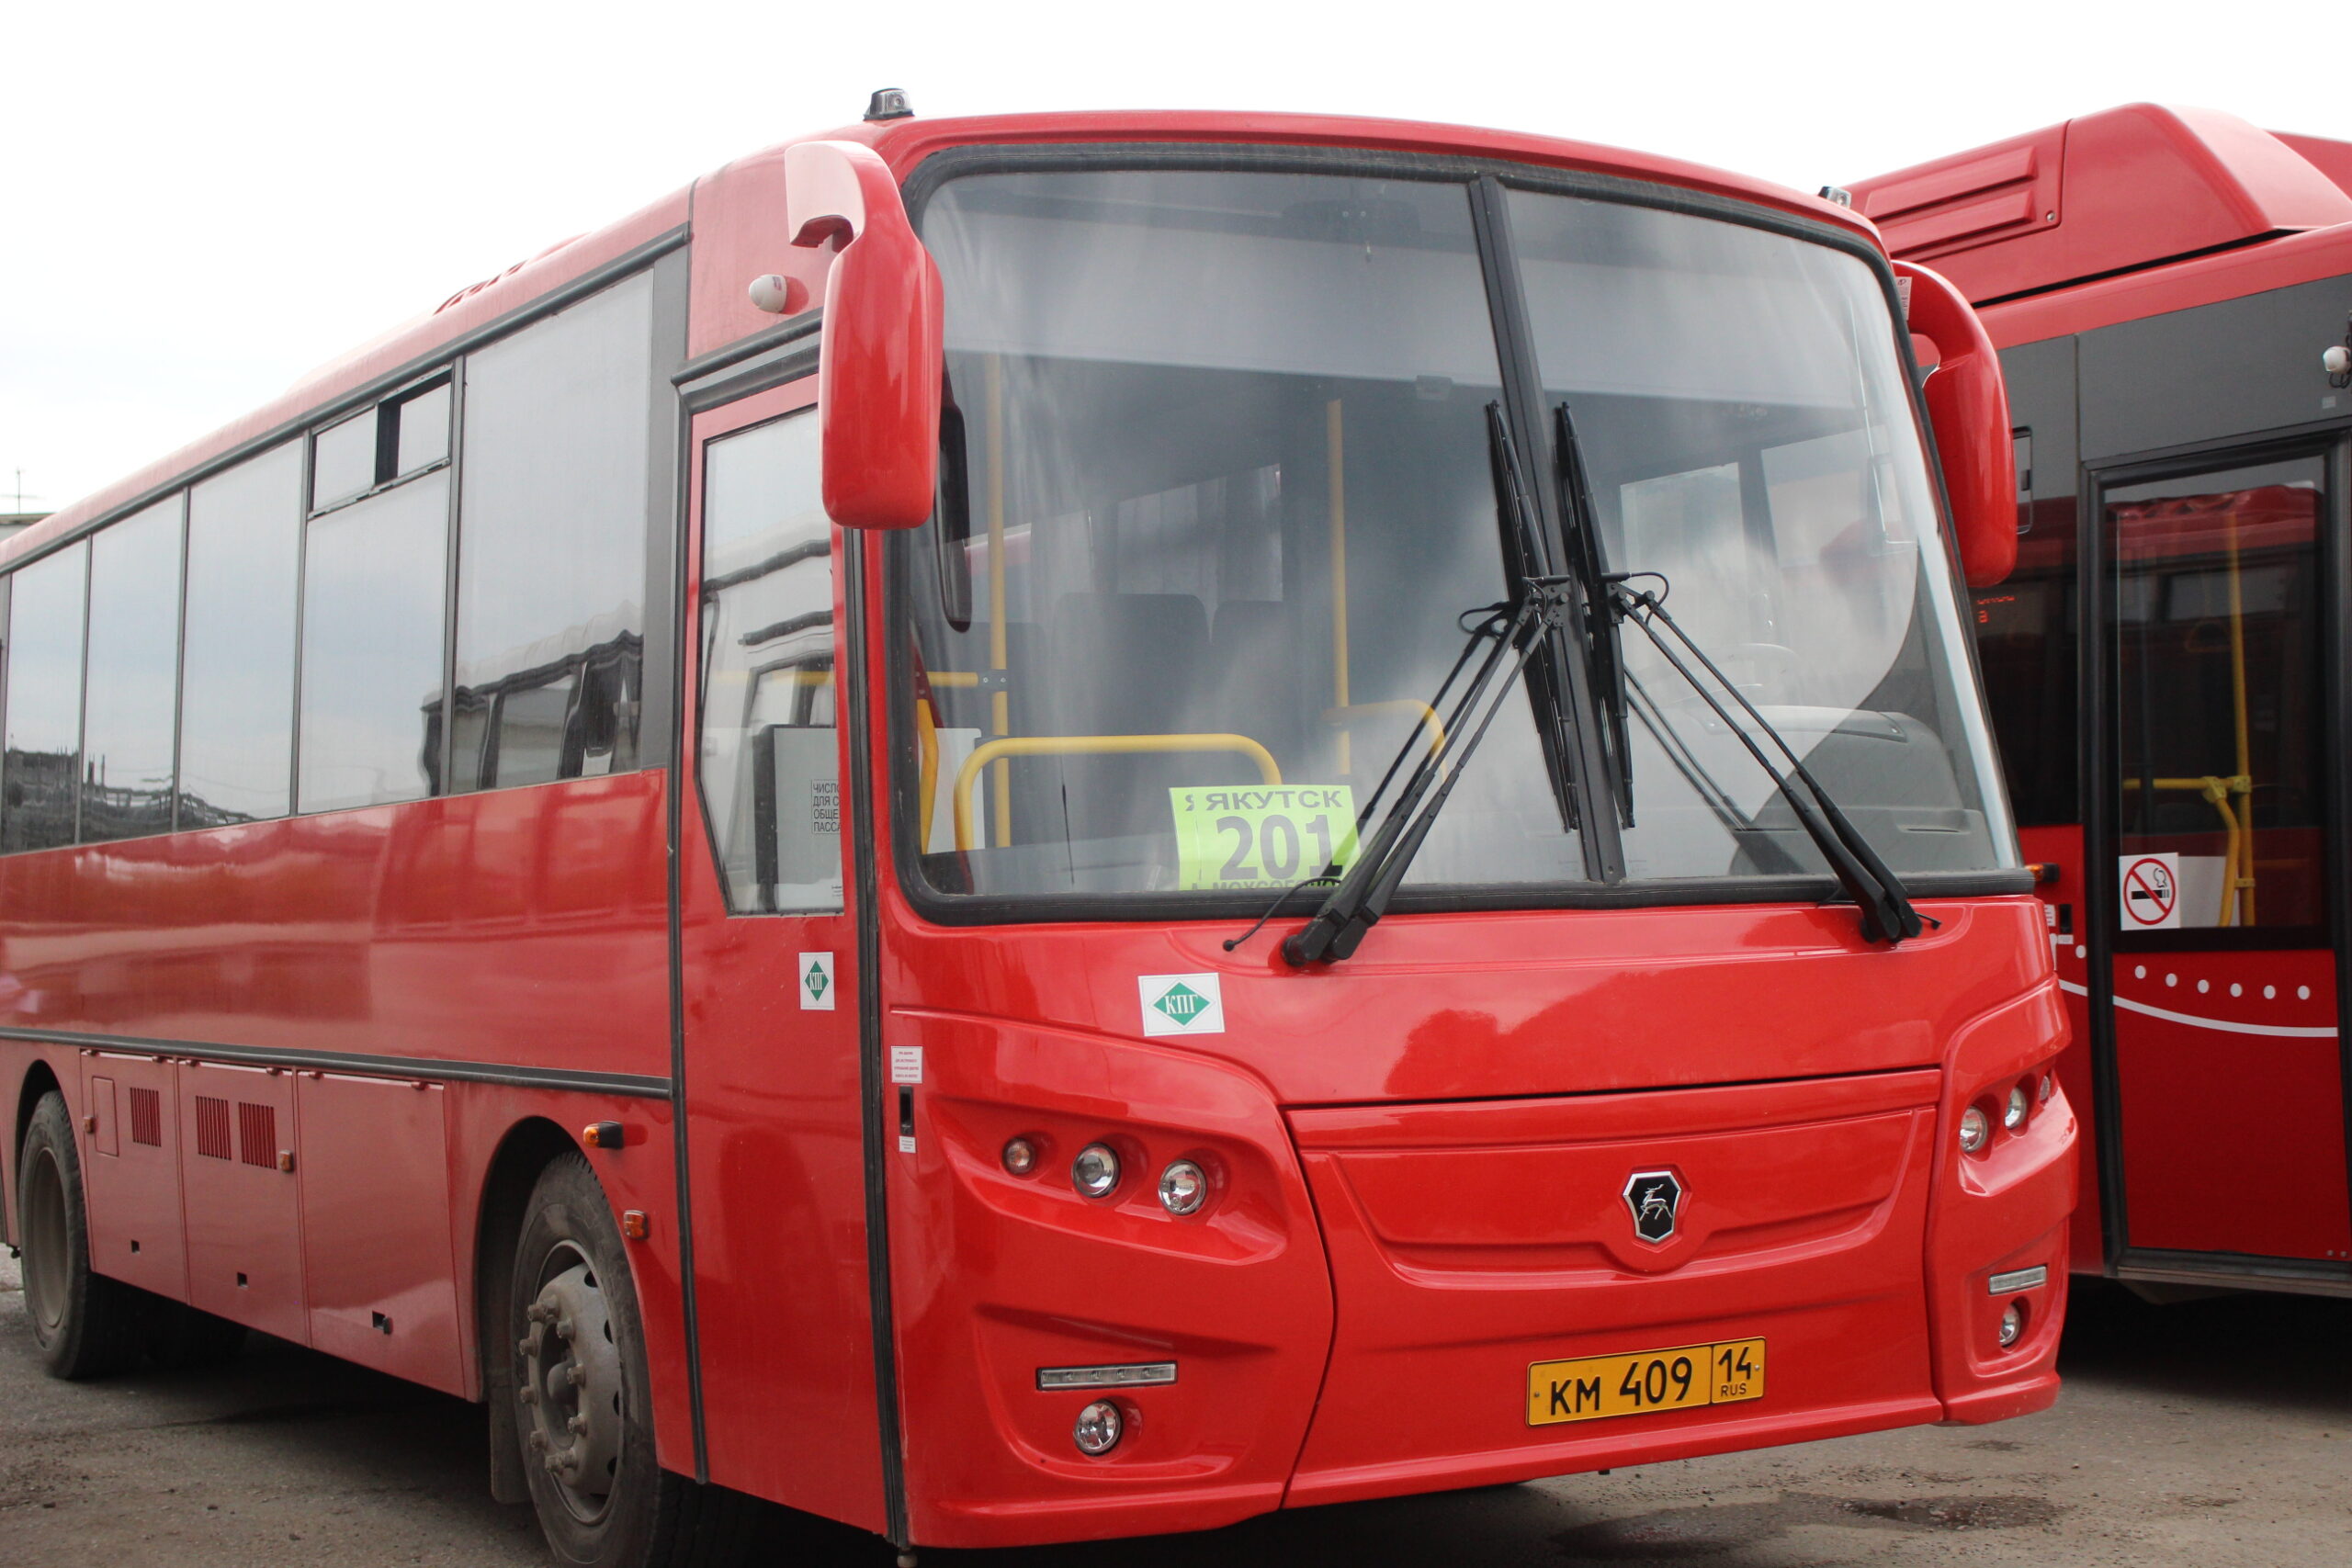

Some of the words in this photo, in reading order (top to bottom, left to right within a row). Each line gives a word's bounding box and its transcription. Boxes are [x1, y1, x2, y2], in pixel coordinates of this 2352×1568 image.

[813, 795, 831, 807] ДЛЯ
[832, 795, 840, 807] С
[1205, 790, 1343, 811] ЯКУТСК
[813, 808, 839, 821] ОБЩЕ
[1216, 814, 1343, 881] 201
[809, 972, 824, 991] КПГ
[1164, 994, 1199, 1015] КПГ
[1550, 1376, 1601, 1416] КМ
[1619, 1356, 1692, 1406] 409
[1717, 1346, 1752, 1382] 14
[1720, 1382, 1747, 1397] RUS
